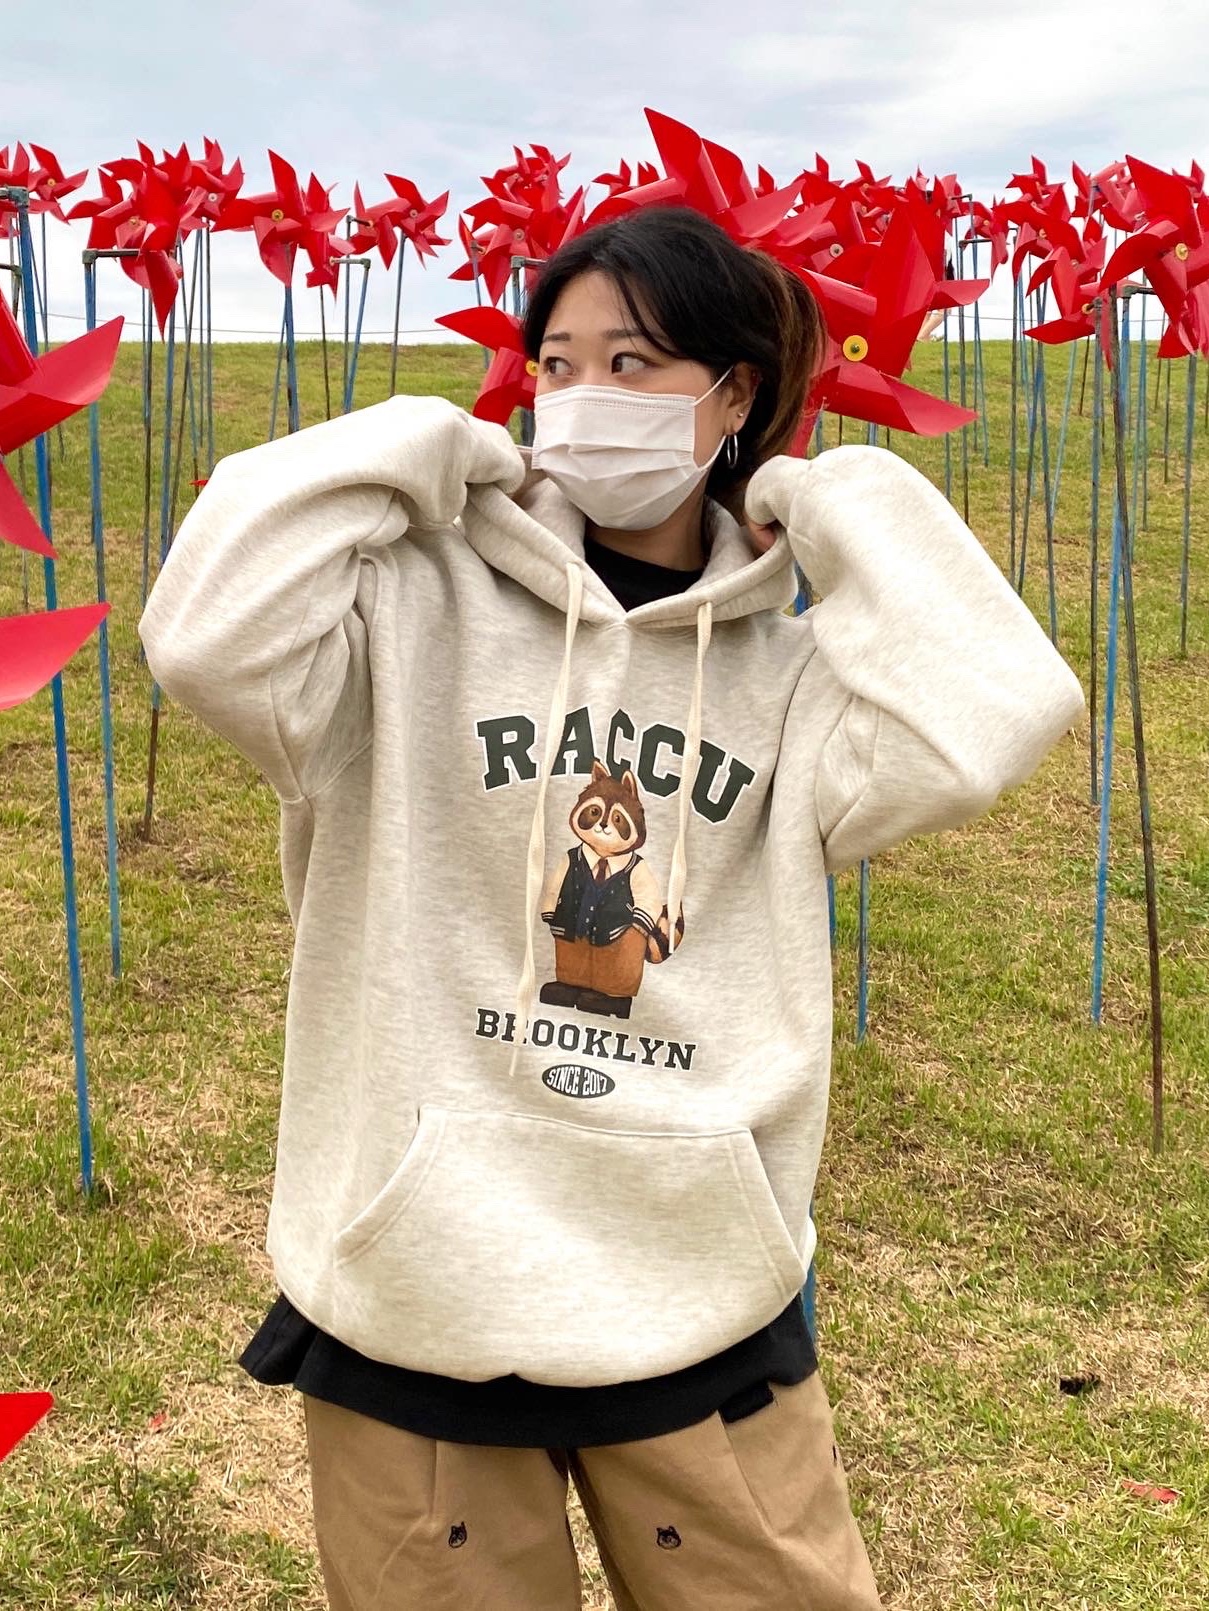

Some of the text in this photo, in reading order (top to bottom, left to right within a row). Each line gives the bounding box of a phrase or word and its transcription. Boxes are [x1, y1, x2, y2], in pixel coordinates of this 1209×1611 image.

[475, 705, 757, 824] RACCU
[546, 1066, 608, 1096] SINCE 2017
